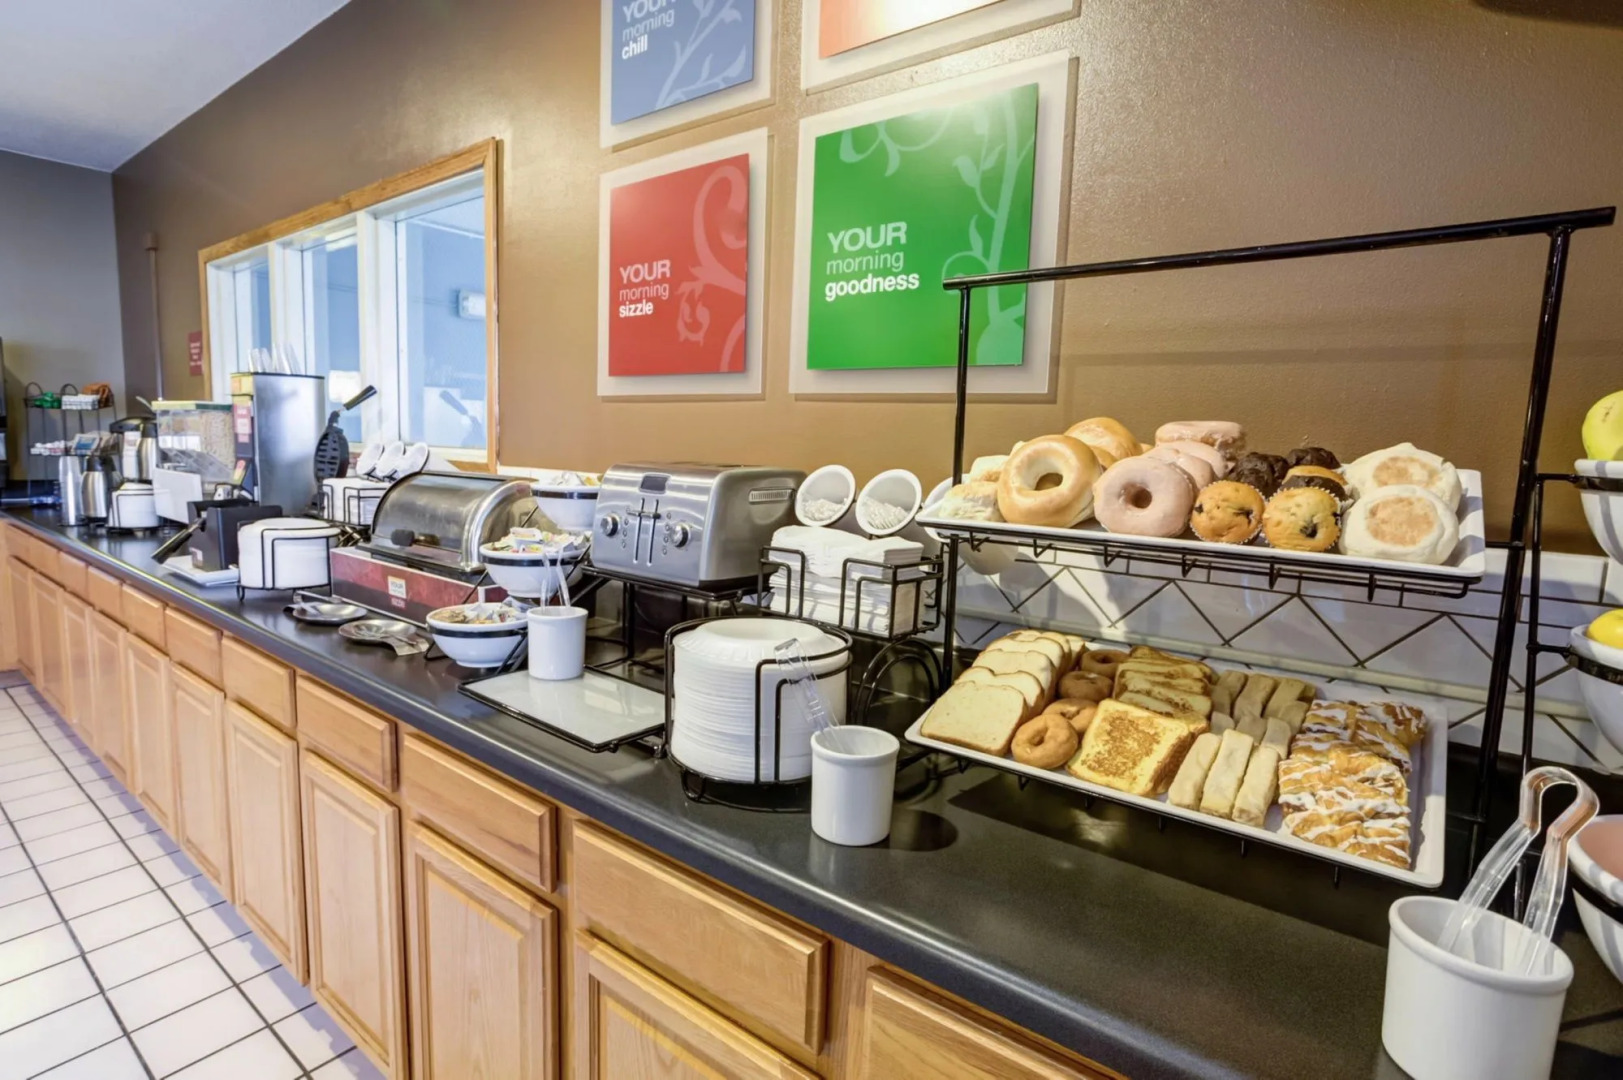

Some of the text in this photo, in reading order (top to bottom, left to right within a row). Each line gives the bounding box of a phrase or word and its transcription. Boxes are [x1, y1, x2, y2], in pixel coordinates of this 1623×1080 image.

[622, 9, 675, 42] morning
[622, 34, 648, 60] chill
[827, 221, 907, 254] YOUR
[620, 259, 671, 285] YOUR
[826, 250, 904, 275] morning
[620, 281, 669, 301] morning
[825, 273, 920, 302] goodness
[619, 299, 654, 318] sizzle
